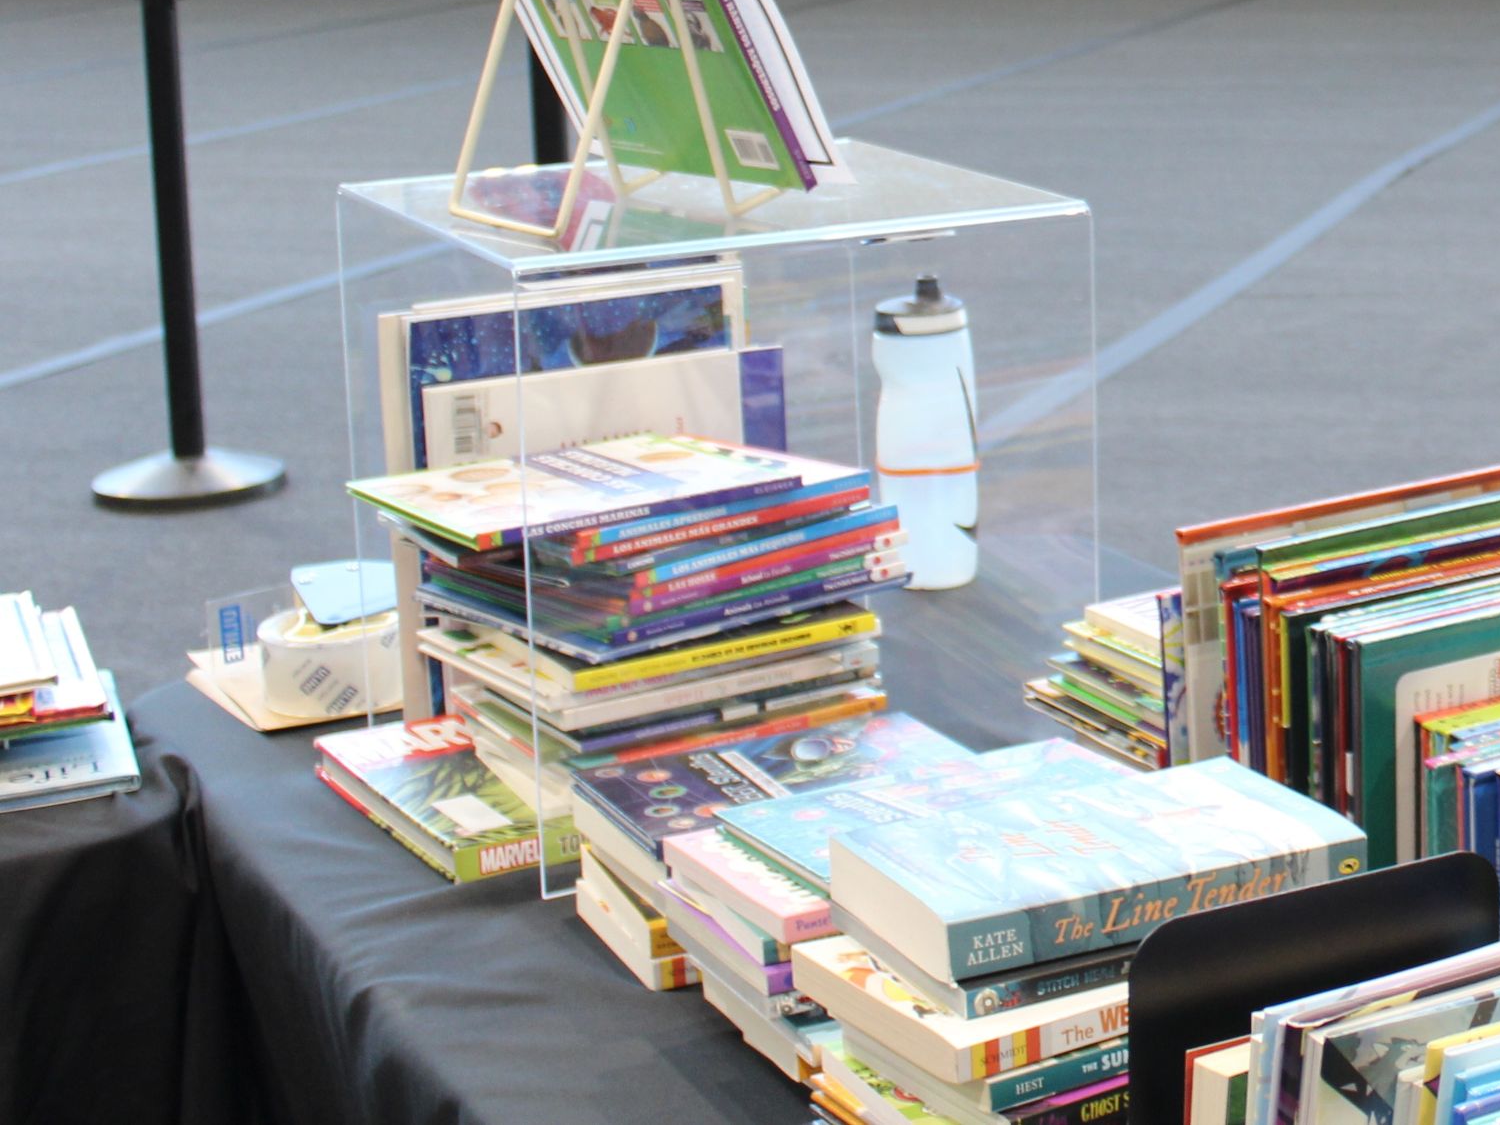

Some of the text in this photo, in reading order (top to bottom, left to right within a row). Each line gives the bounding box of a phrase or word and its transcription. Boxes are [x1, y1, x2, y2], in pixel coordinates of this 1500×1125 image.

[544, 514, 598, 535] CONCHAS
[598, 505, 651, 525] MARINAS
[629, 532, 688, 551] ANIMALES
[480, 838, 542, 874] MARVEL
[1053, 867, 1289, 945] The Line Tender
[966, 941, 1025, 967] ALLEN
[973, 928, 1018, 950] KATE
[1036, 971, 1081, 996] STITCH
[980, 1044, 1028, 1068] SCHMIDT
[1061, 1024, 1094, 1046] The
[1014, 1076, 1046, 1096] HEST
[1081, 1062, 1099, 1074] THE
